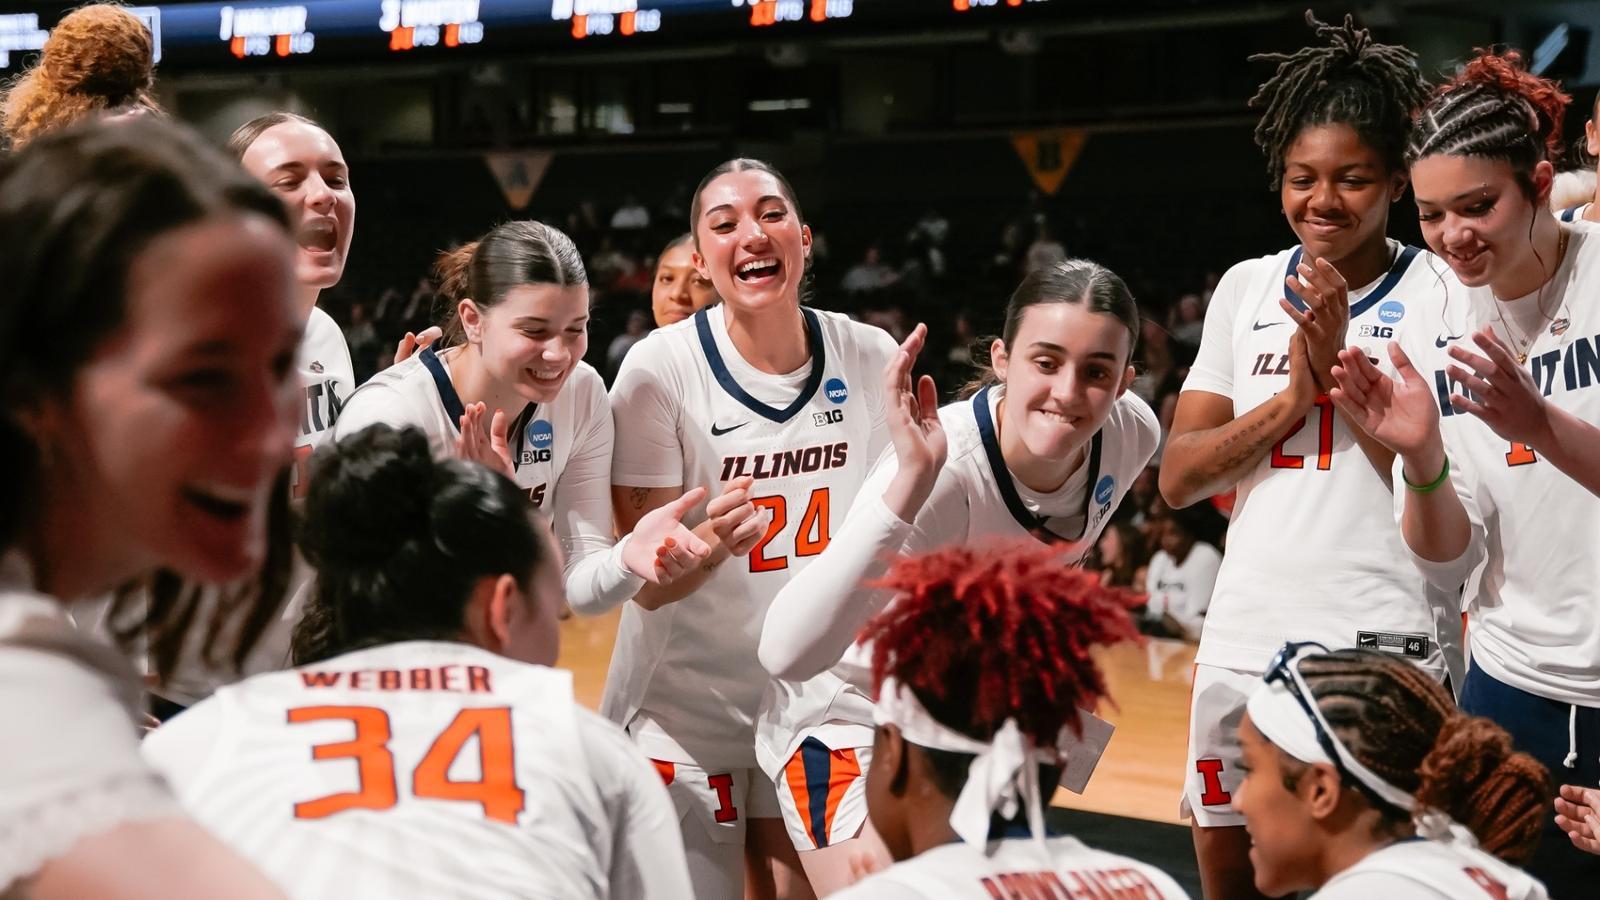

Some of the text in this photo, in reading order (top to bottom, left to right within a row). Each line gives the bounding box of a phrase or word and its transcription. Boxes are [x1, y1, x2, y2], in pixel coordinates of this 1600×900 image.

[829, 389, 848, 399] NCAA
[532, 432, 552, 443] NCAA
[720, 442, 848, 481] ILLINOIS
[749, 487, 831, 573] 24
[1408, 641, 1420, 652] 46
[301, 665, 493, 693] WEBBER
[286, 704, 526, 827] 34
